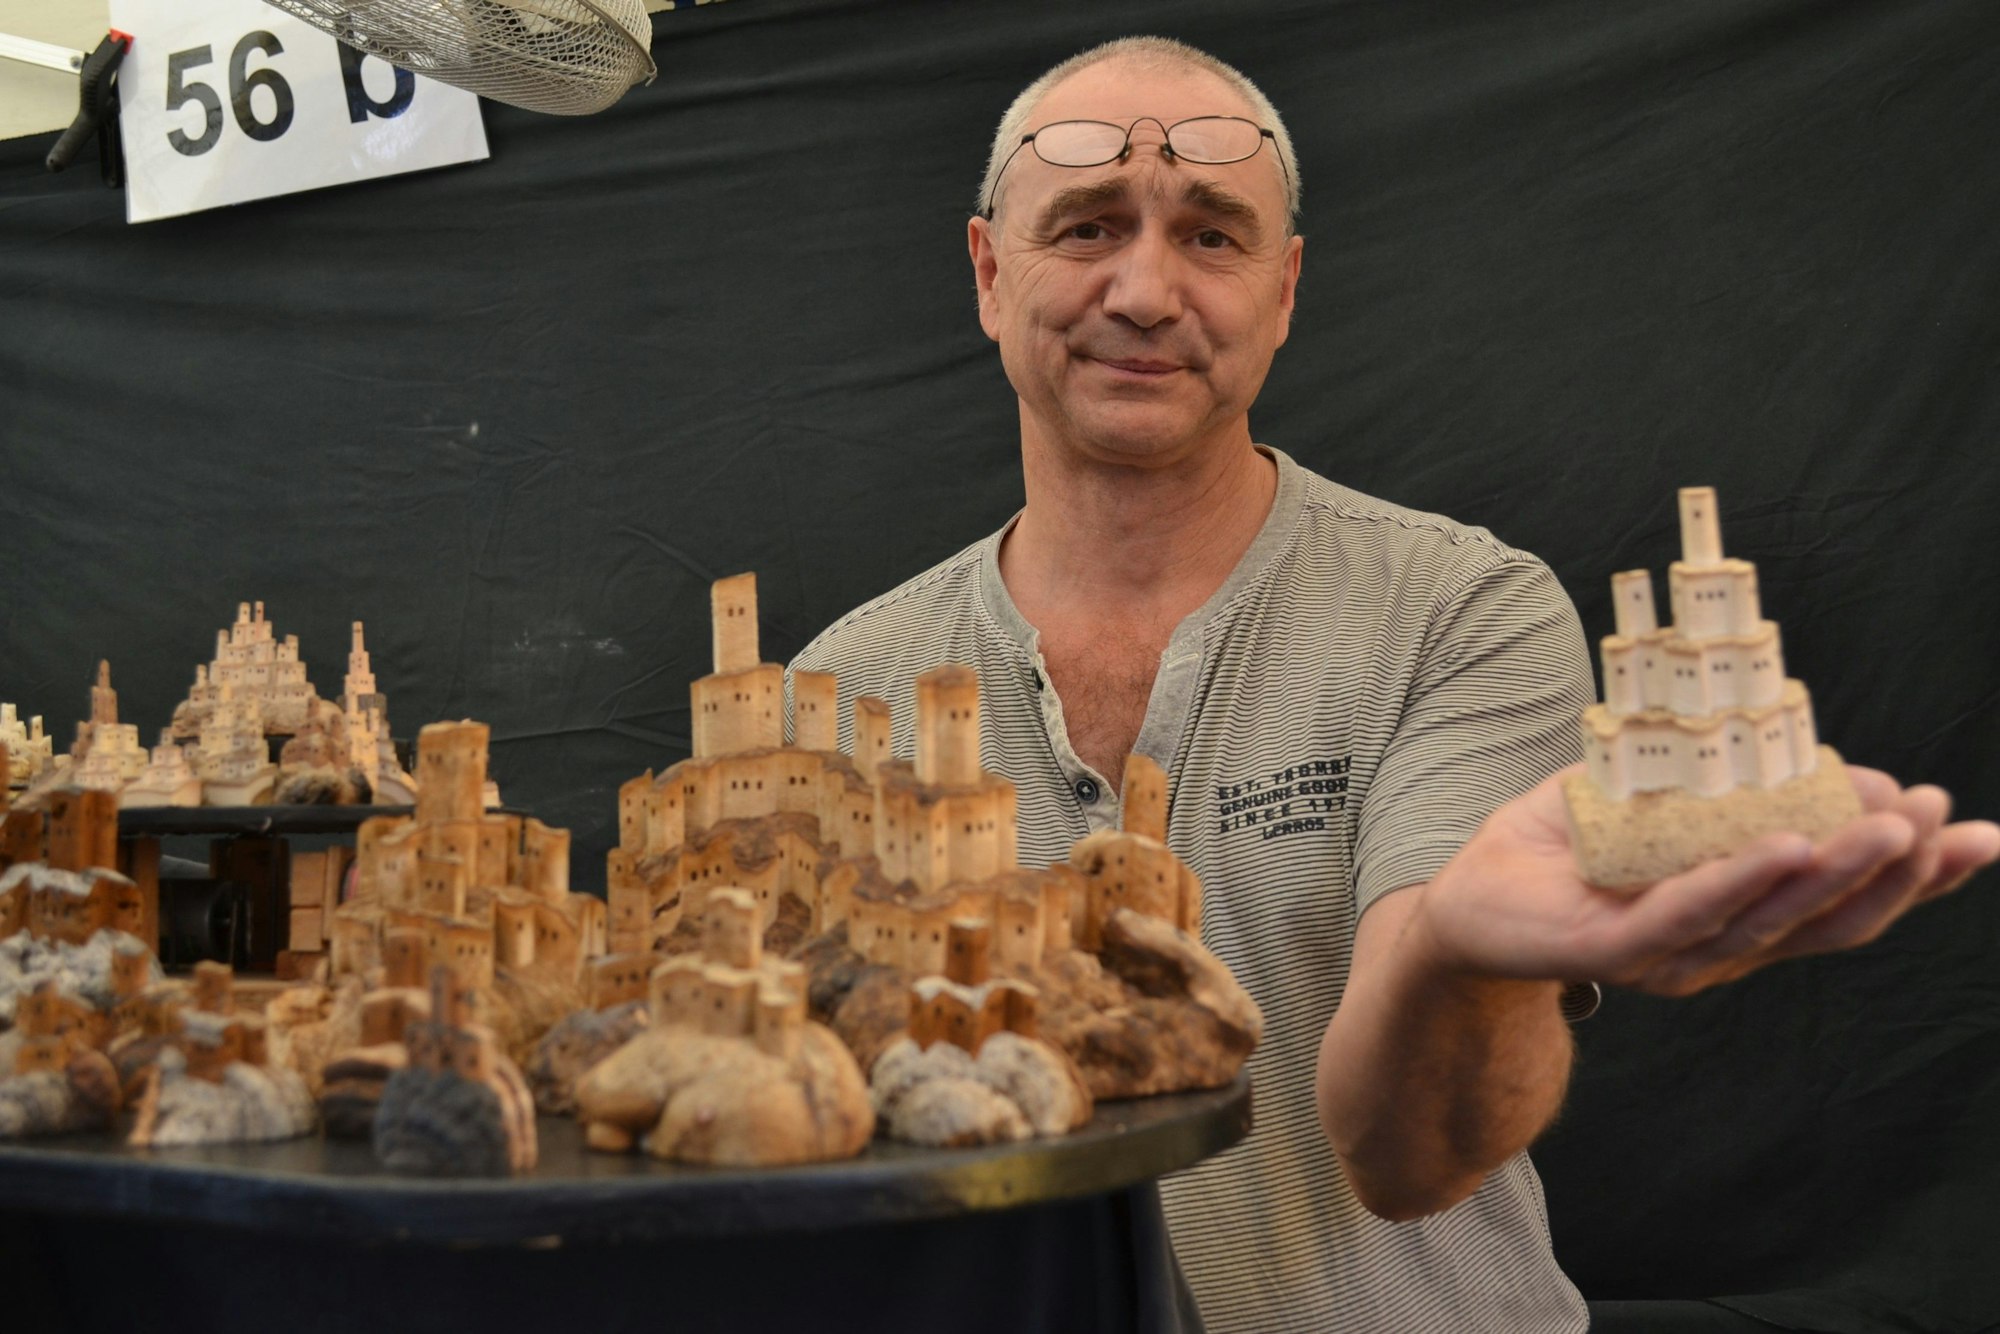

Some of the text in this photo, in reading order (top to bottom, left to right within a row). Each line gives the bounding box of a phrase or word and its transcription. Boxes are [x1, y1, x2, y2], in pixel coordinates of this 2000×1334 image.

[165, 29, 416, 157] 56 b
[1220, 786, 1292, 816] GENUINE
[1220, 803, 1291, 833] SINCE
